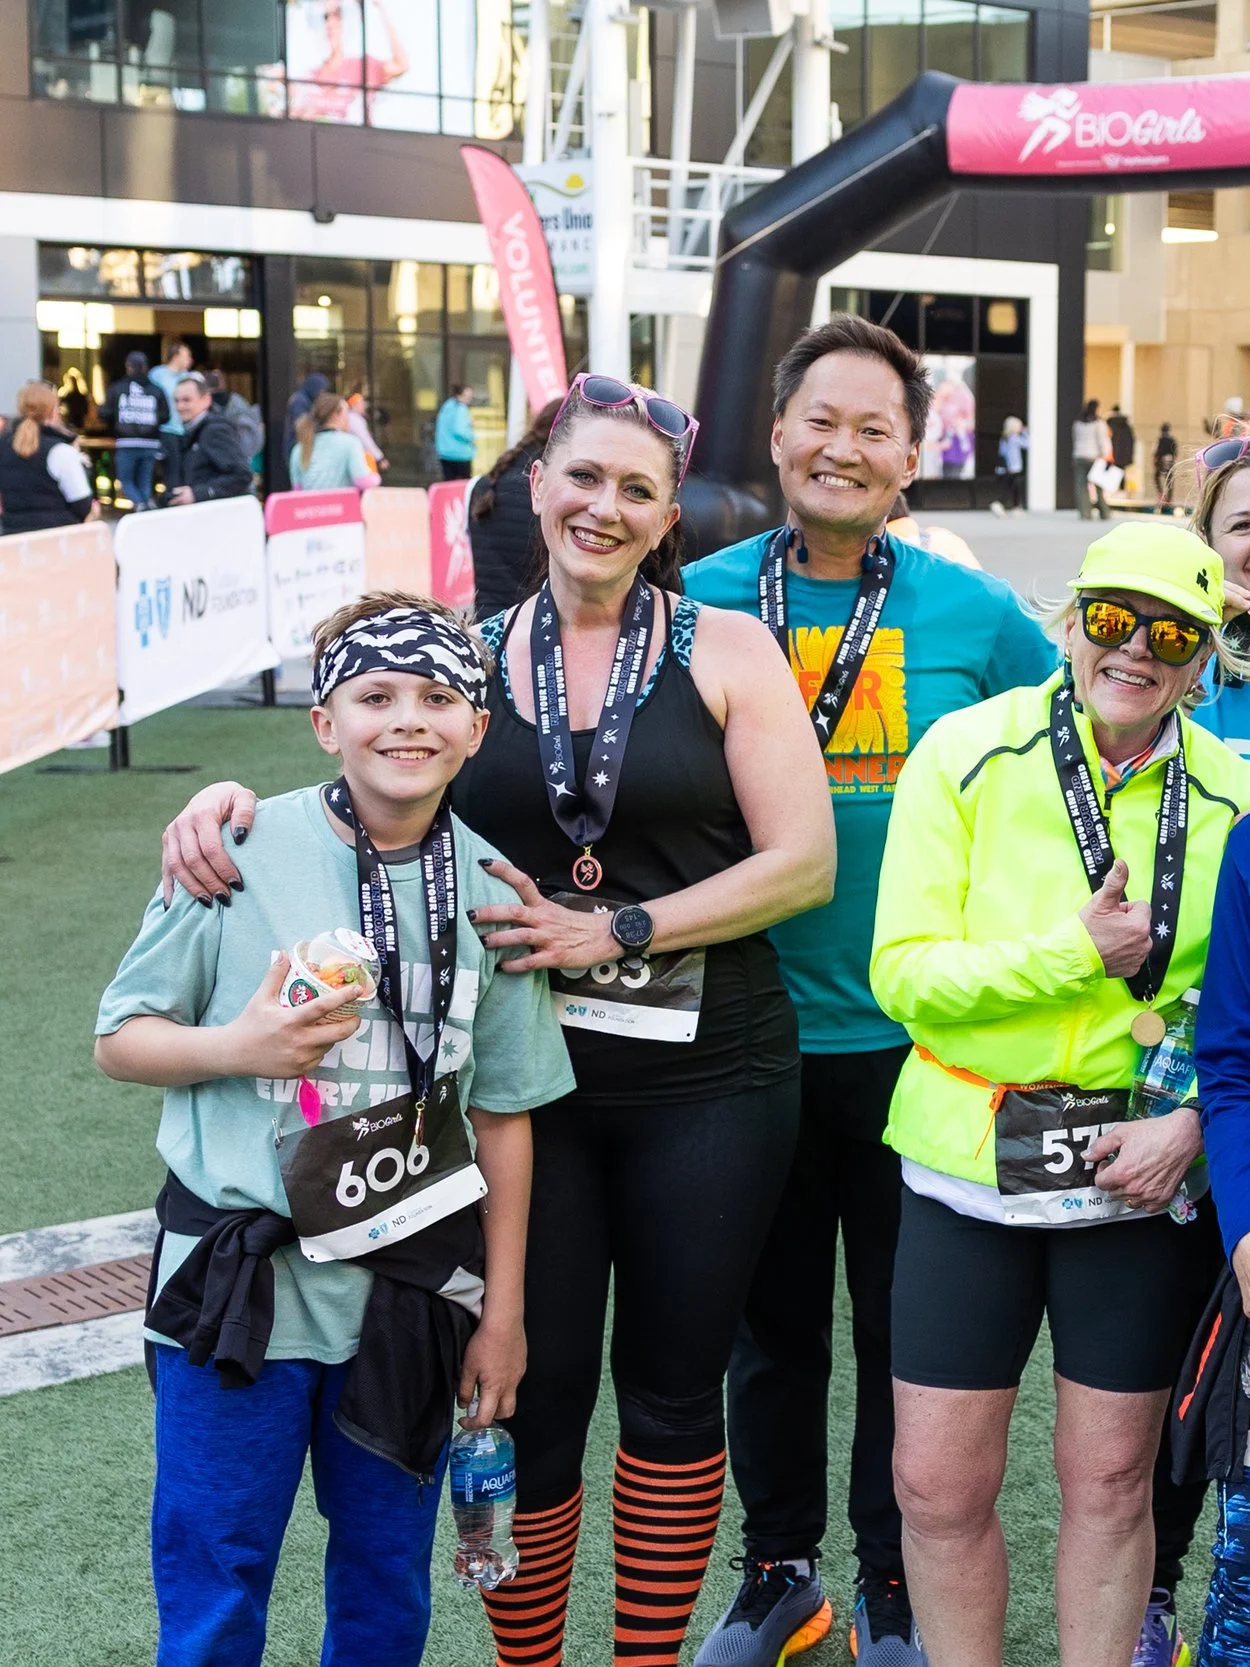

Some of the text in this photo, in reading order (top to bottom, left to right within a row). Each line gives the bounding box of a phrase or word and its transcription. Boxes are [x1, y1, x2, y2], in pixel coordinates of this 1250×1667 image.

[1075, 107, 1206, 148] BIOGirls
[503, 209, 564, 402] VOLUNTE
[182, 578, 208, 624] ND
[824, 755, 906, 784] NNER
[591, 1009, 606, 1019] ND
[1154, 1055, 1192, 1075] AQUAF
[256, 1078, 361, 1107] EVRY
[1042, 1122, 1118, 1175] 57
[335, 1135, 430, 1208] 606
[1088, 1197, 1103, 1206] ND
[392, 1215, 407, 1228] ND
[481, 1470, 516, 1492] AQUAF
